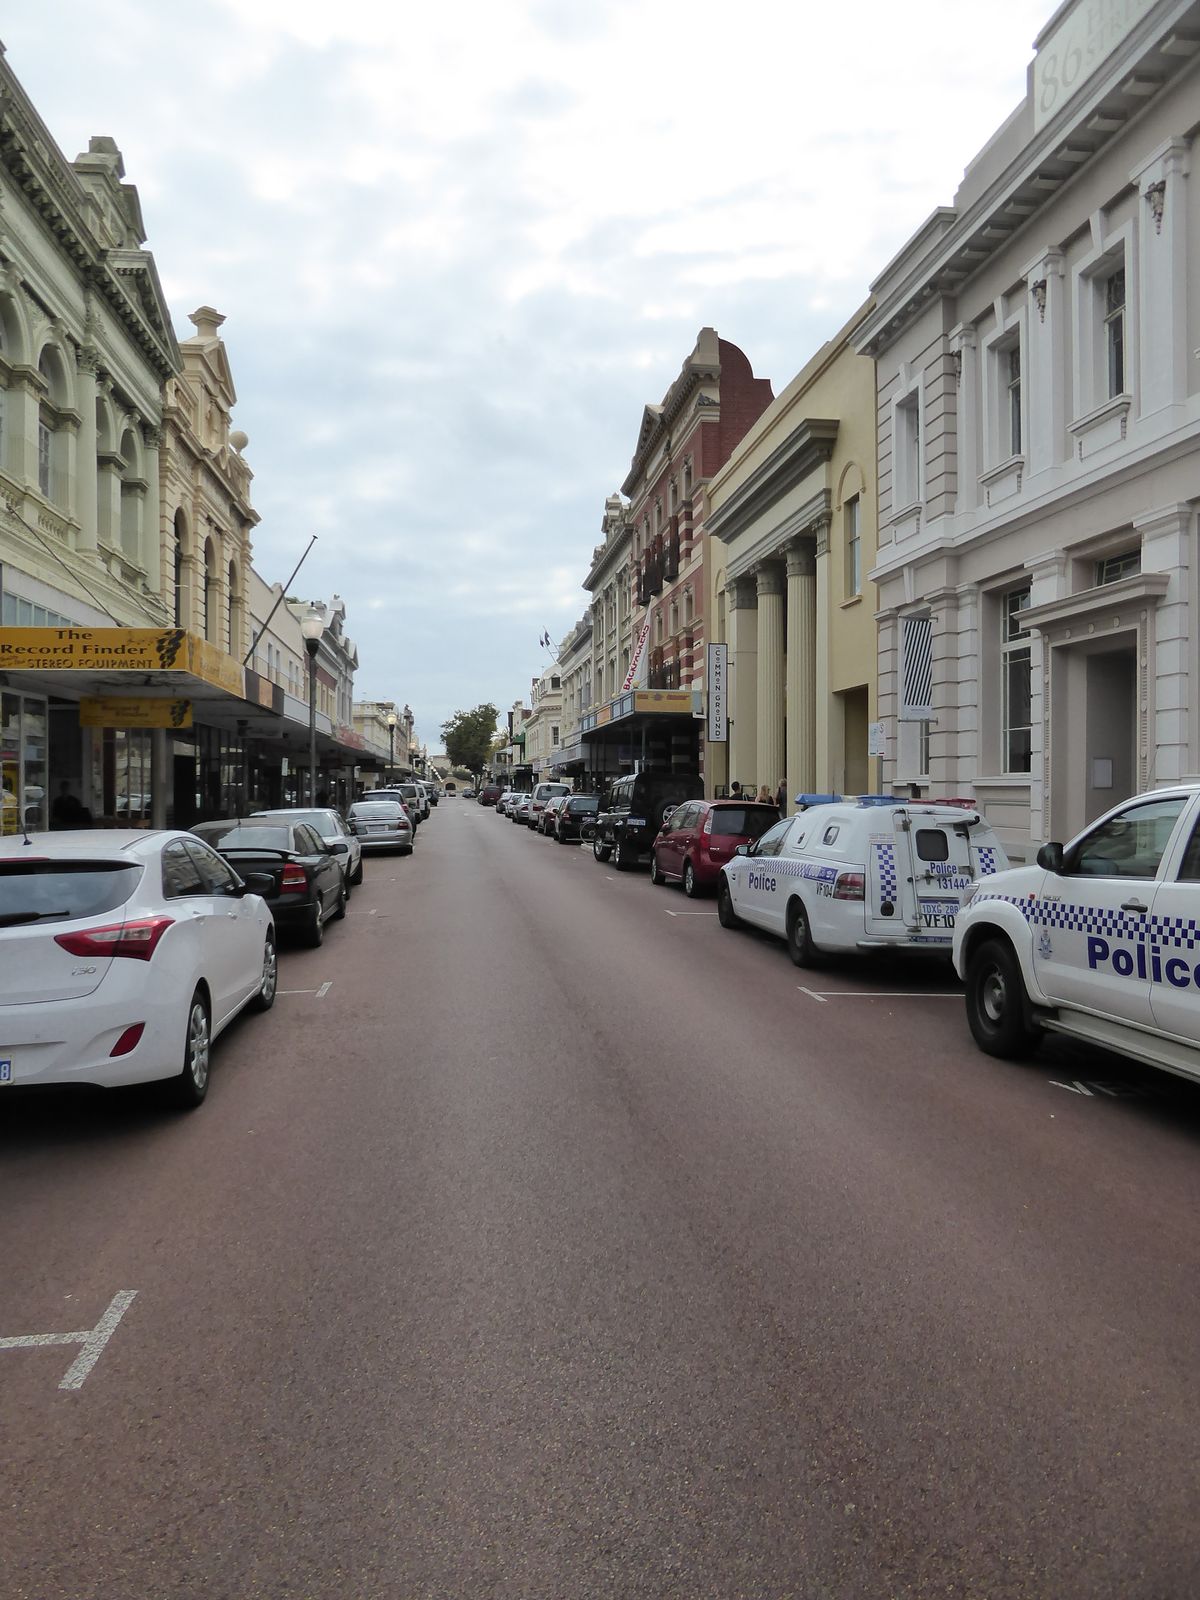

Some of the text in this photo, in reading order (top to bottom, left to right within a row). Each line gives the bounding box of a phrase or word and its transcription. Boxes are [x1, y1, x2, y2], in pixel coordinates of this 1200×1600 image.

[55, 630, 93, 640] The
[1, 644, 147, 655] Record Finder
[27, 659, 73, 669] STEREO
[79, 659, 153, 669] EQUIPMENT
[930, 862, 957, 875] Police
[748, 872, 776, 892] Police
[923, 914, 955, 928] VF10
[1087, 935, 1200, 990] Polic
